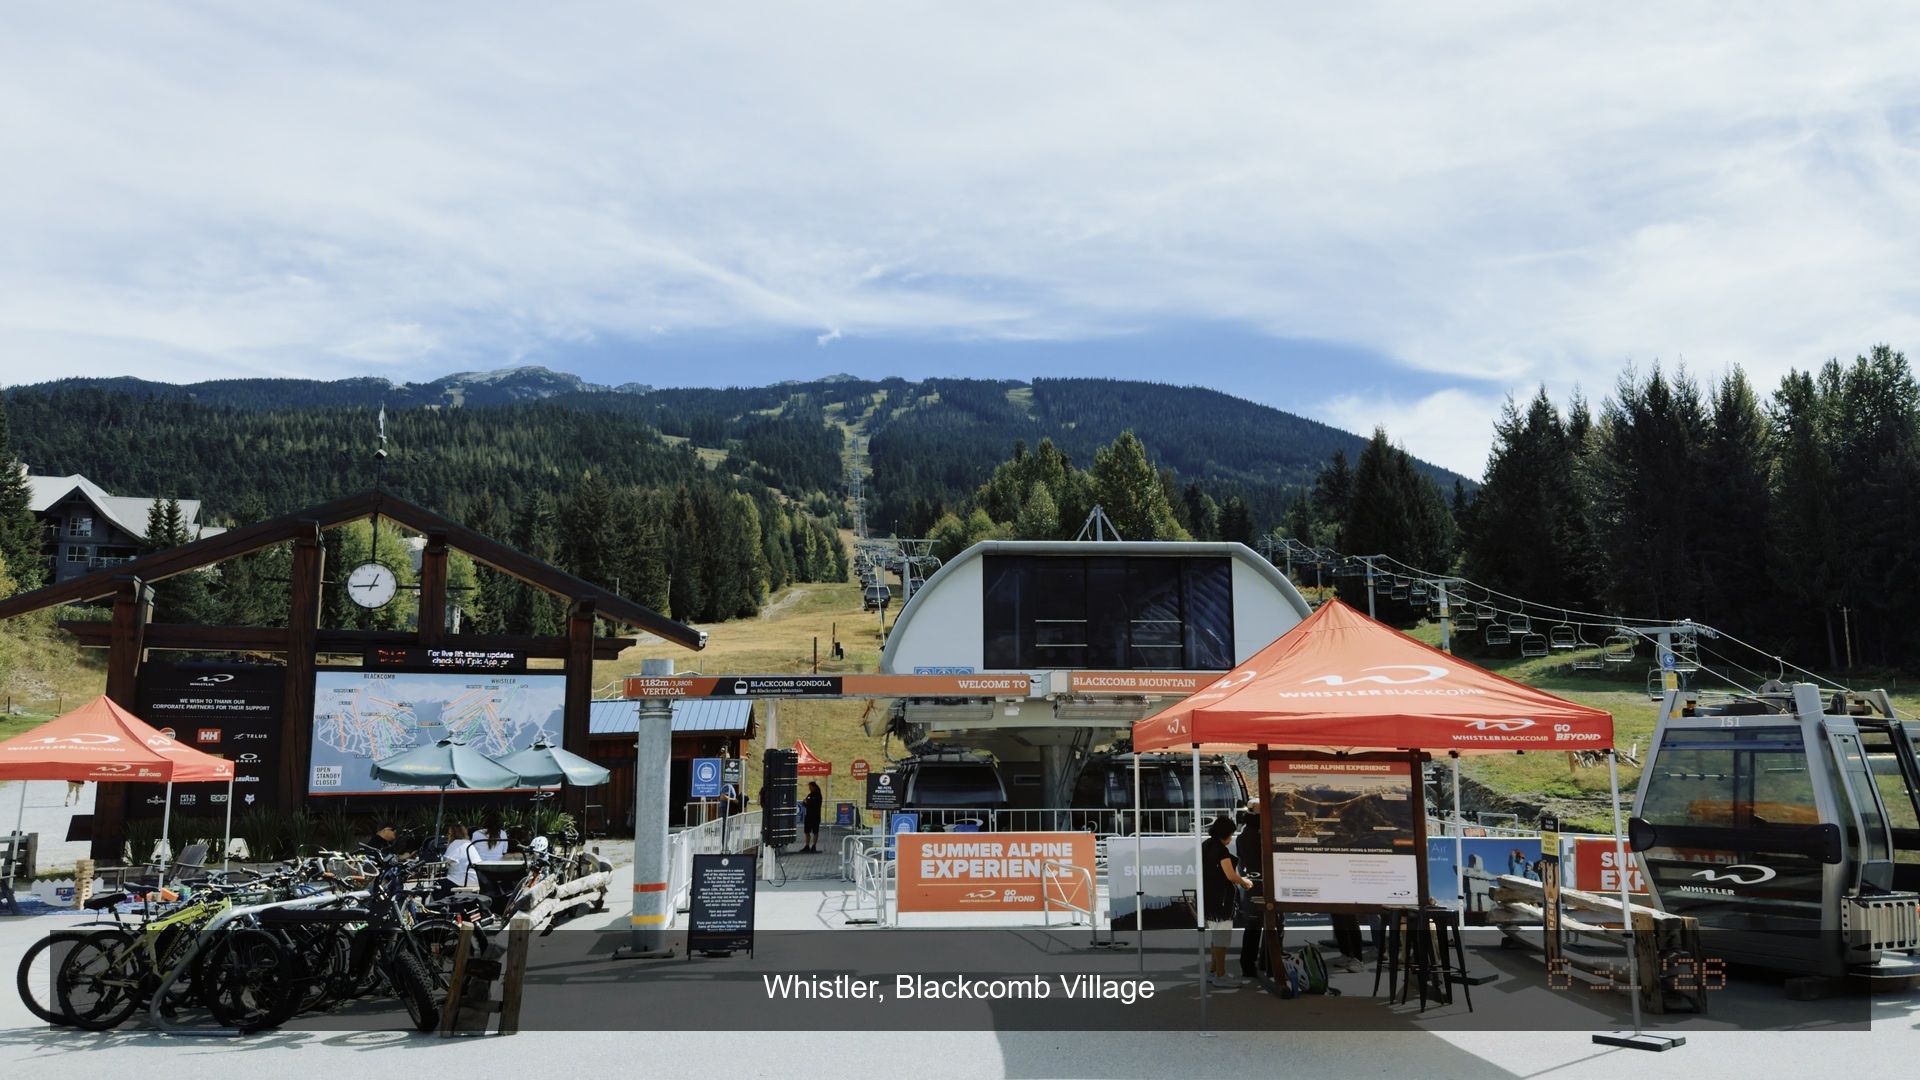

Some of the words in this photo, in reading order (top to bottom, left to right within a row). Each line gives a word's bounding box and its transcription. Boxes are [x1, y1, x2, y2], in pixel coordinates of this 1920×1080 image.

[958, 680, 1010, 689] WELCOME
[1012, 680, 1026, 688] TO
[1073, 677, 1136, 686] BLACKCOMB
[1139, 678, 1196, 687] MOUNTAIN
[1279, 689, 1383, 698] WHISTLER
[1720, 718, 1740, 727] 151
[1554, 724, 1570, 732] GO
[1555, 733, 1601, 741] BEYOND
[921, 843, 1003, 857] SUMMER
[1007, 843, 1073, 856] ALPINE
[920, 859, 1073, 879] EXPERIENCE
[1680, 885, 1735, 895] WHISTLER
